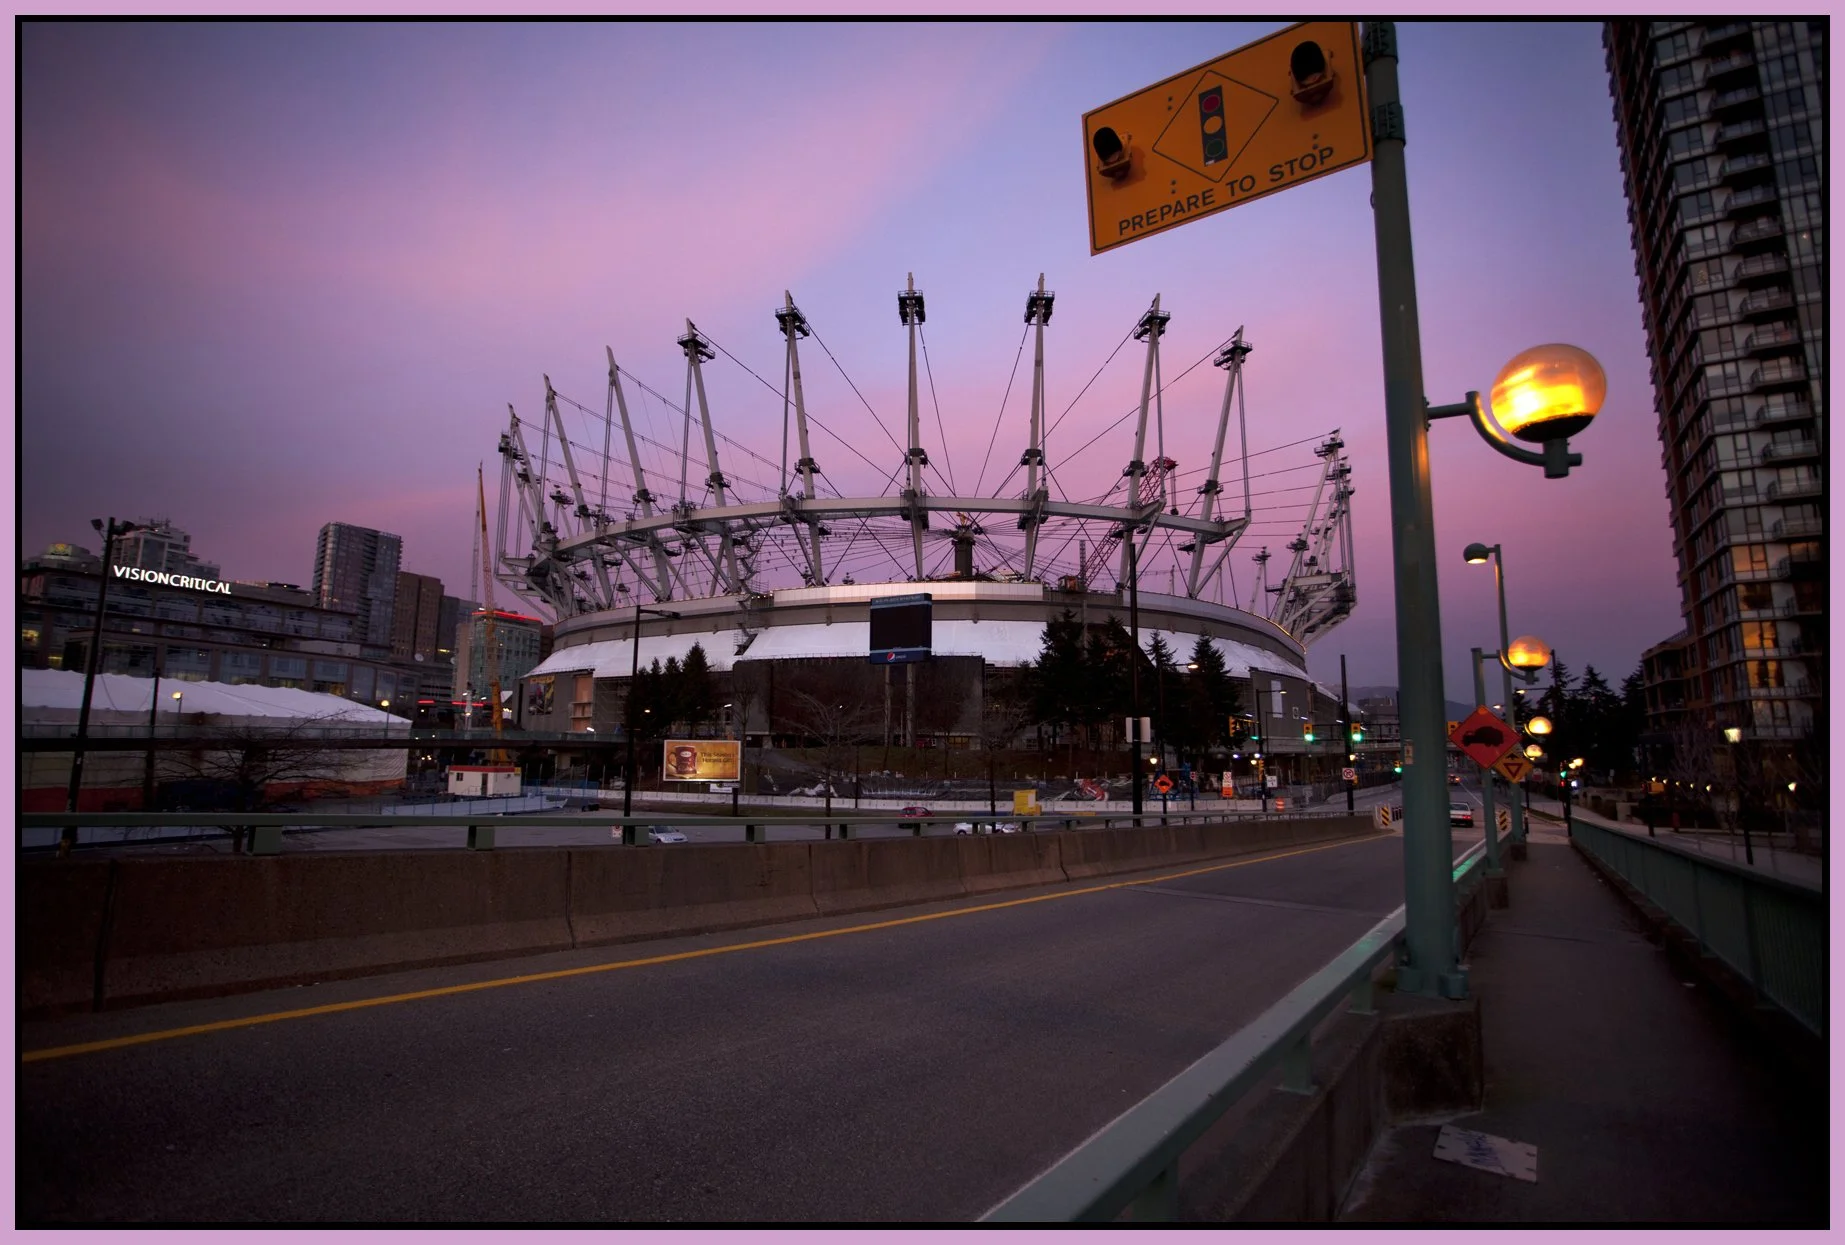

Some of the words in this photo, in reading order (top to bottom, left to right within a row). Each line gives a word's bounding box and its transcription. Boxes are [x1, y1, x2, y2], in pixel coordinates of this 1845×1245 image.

[1118, 188, 1215, 236] PREPARE
[1226, 175, 1256, 197] TO
[1269, 146, 1334, 182] STOP
[113, 564, 232, 594] VISIONCRITICAL
